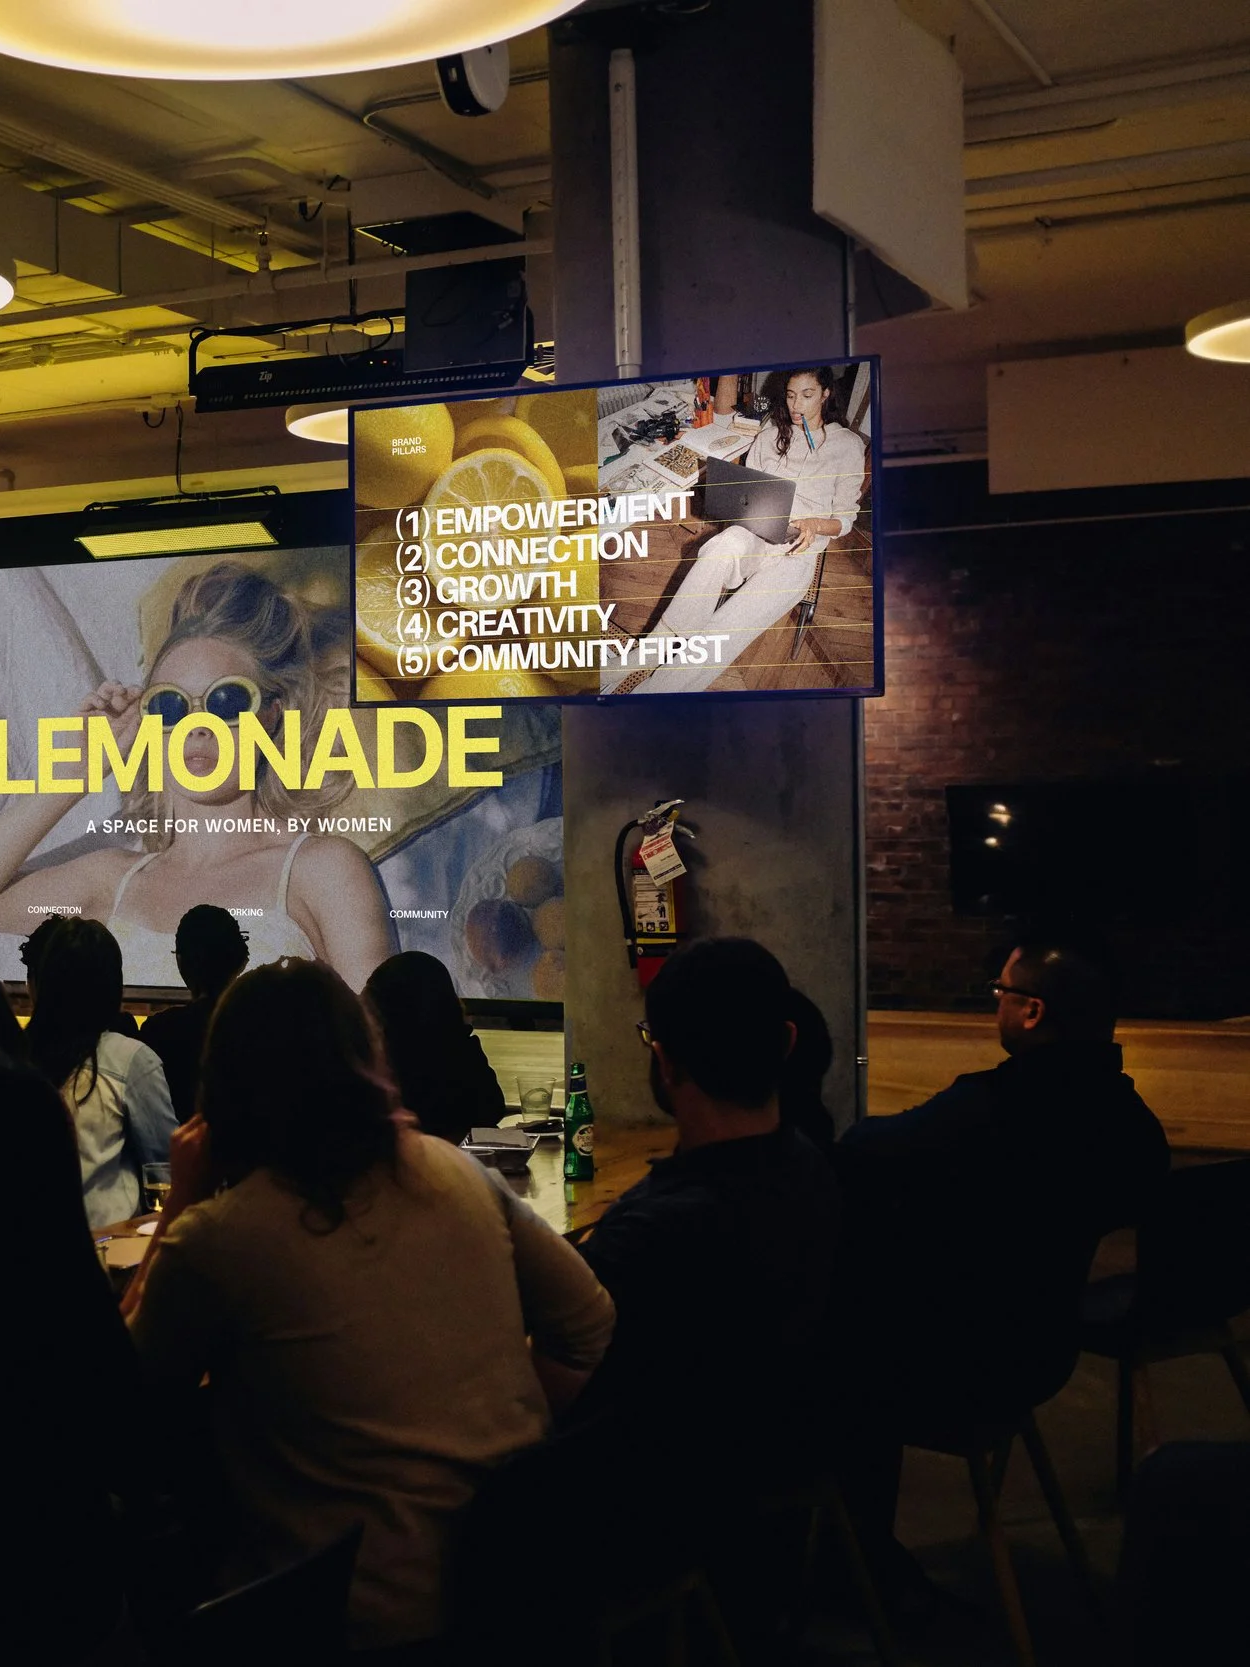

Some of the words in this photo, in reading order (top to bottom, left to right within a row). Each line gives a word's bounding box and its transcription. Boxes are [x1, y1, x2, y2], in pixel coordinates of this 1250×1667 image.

[391, 436, 422, 447] BRAND
[391, 445, 427, 456] PILLARS
[395, 508, 431, 541] (1)
[436, 491, 695, 536] EMPOWERMENT
[395, 540, 431, 575] (2)
[436, 530, 649, 570] CONNECTION
[396, 574, 431, 607] (3)
[436, 570, 577, 603] GROWTH
[396, 608, 431, 642] (4)
[436, 603, 616, 639] CREATIVITY
[396, 643, 431, 677] (5)
[86, 819, 97, 834] A
[102, 819, 159, 834] SPACE
[164, 818, 199, 833] FOR
[205, 818, 281, 836] WOMEN,
[287, 817, 311, 833] BY
[318, 816, 392, 832] WOMEN
[27, 905, 82, 915] CONNECTION
[389, 909, 449, 919] COMMUNITY
